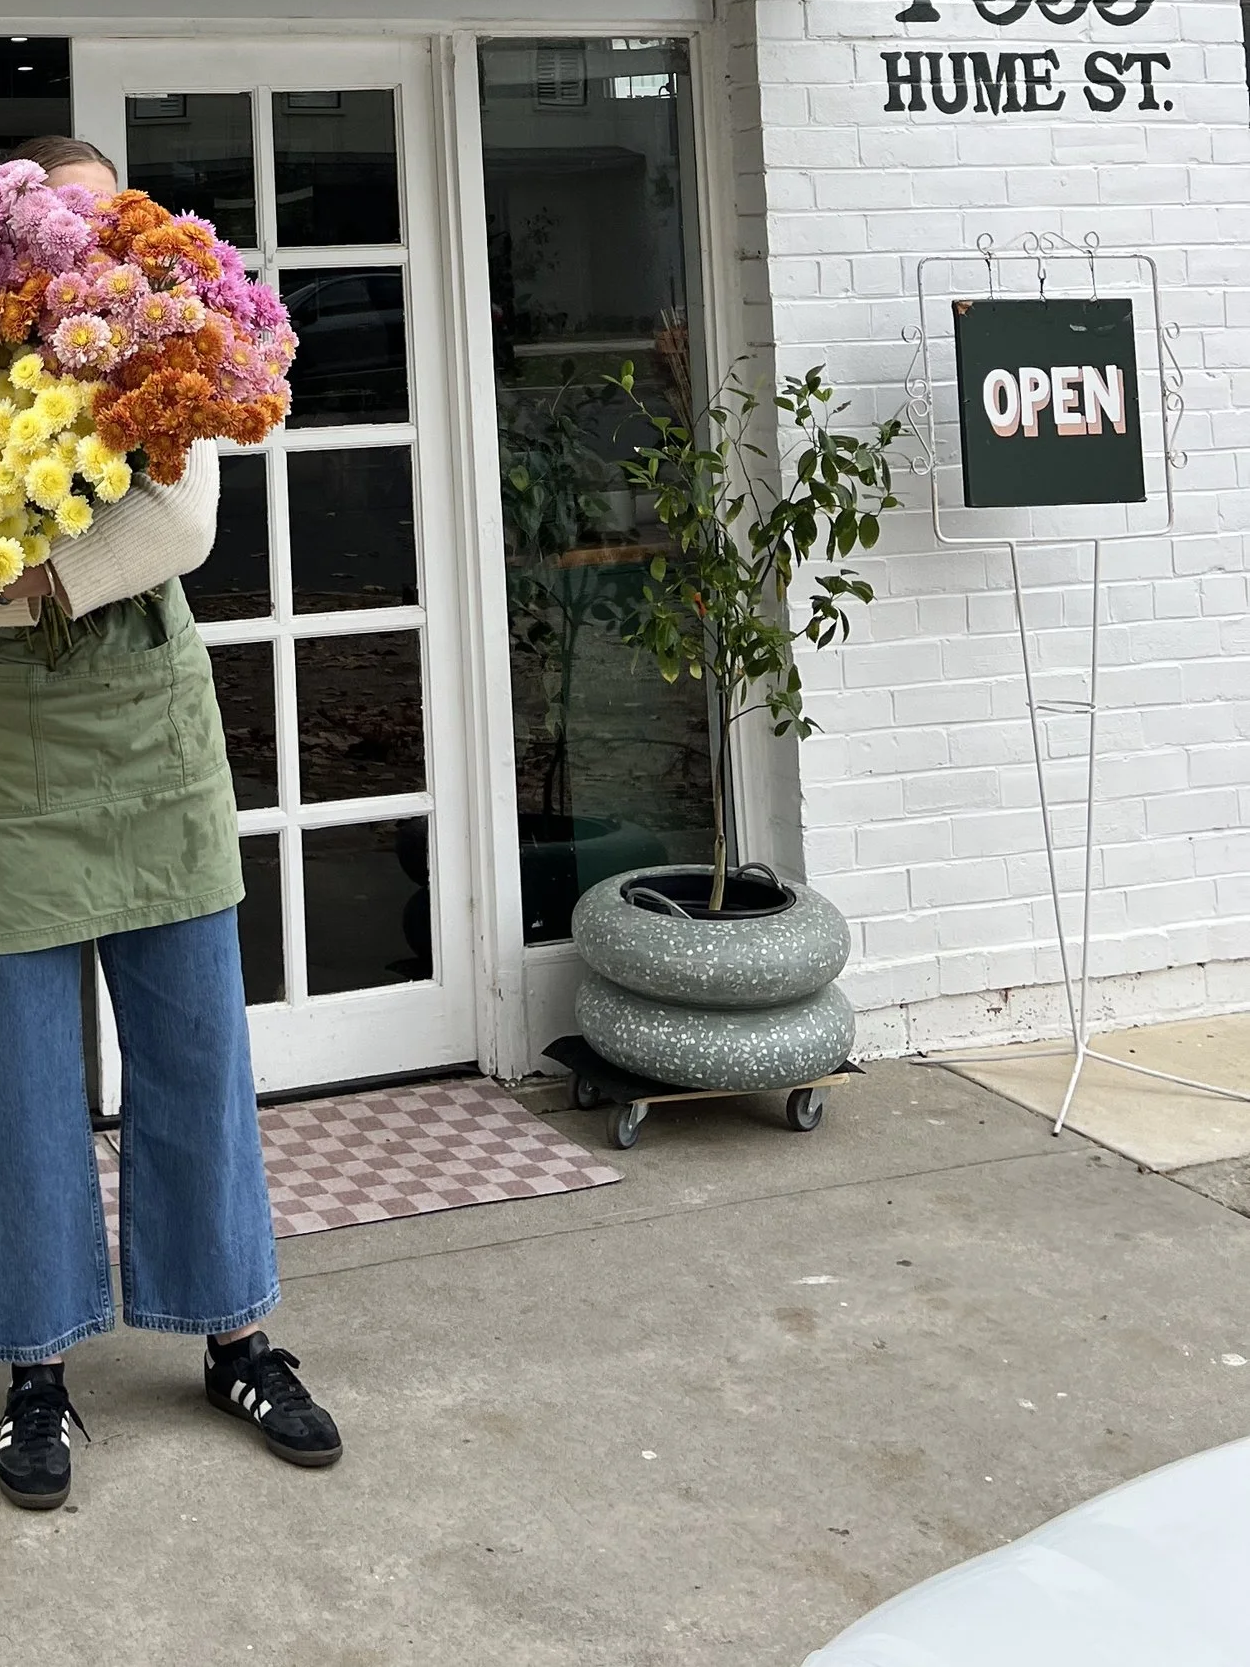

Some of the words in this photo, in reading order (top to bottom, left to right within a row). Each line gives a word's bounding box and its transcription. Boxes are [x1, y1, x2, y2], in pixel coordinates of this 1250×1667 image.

[880, 48, 1067, 116] HUME
[1082, 50, 1175, 113] ST.
[982, 364, 1126, 438] OPEN
